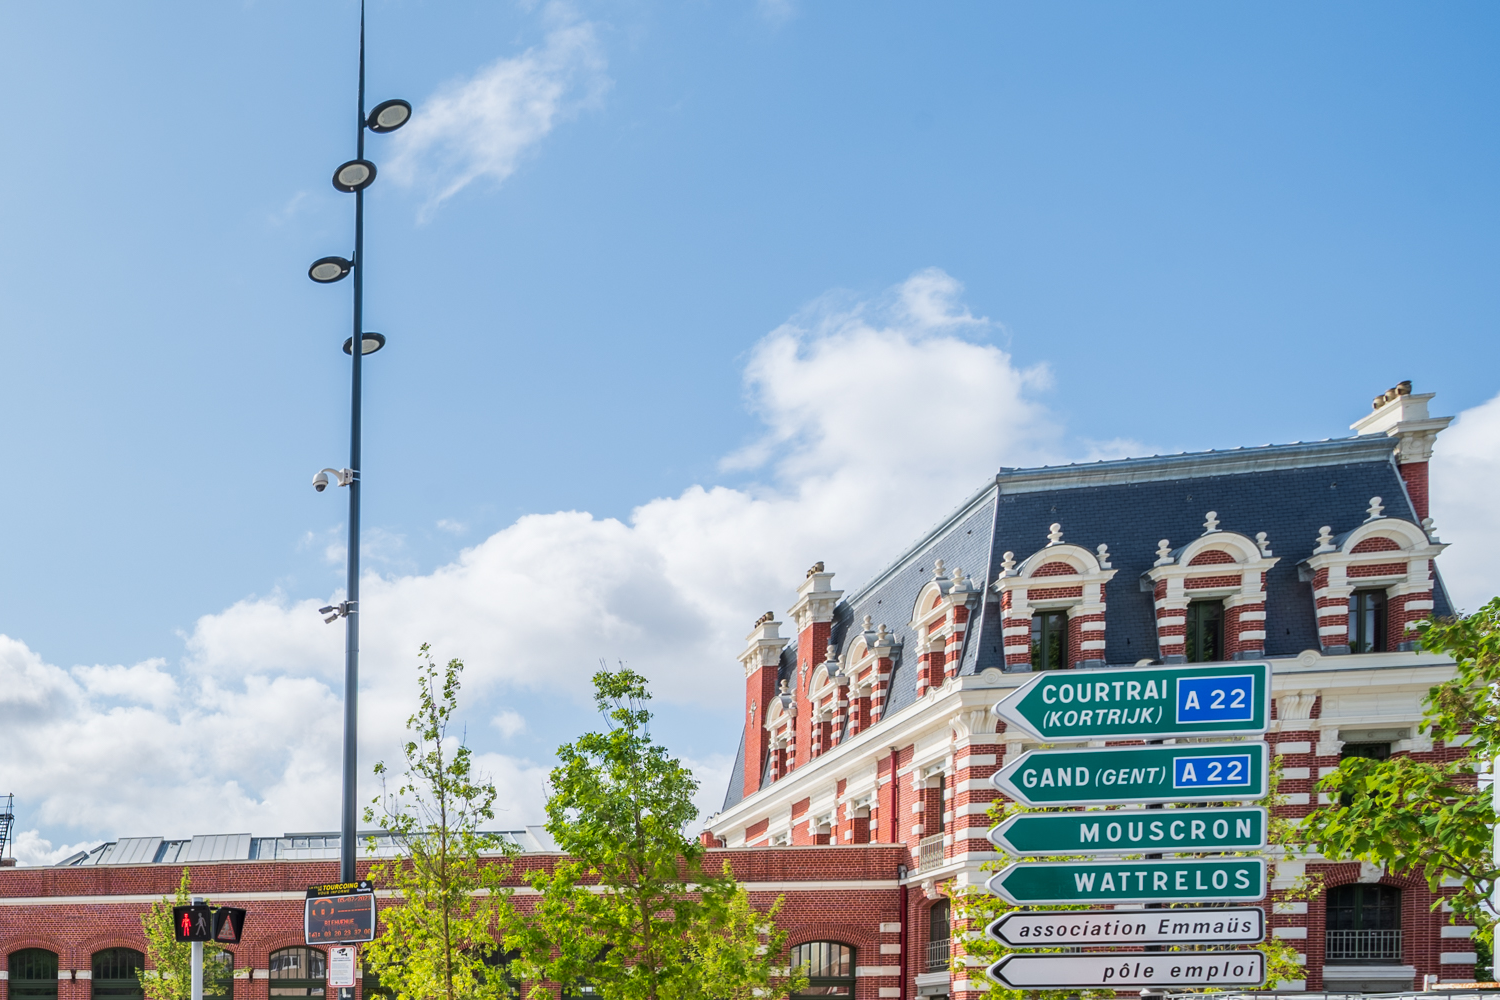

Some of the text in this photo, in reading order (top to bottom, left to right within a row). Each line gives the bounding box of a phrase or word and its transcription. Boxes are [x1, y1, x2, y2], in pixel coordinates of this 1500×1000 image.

[1042, 679, 1167, 704] COURTRAI
[1184, 688, 1246, 710] A 22
[1042, 706, 1163, 728] (KORTRIJK)
[1022, 765, 1167, 788] GAND (GENT)
[1182, 761, 1243, 782] A 22
[1079, 818, 1251, 843] MOUSCRON
[323, 882, 359, 891] TOURCOING
[1074, 869, 1250, 892] WATTRELOS
[1019, 917, 1252, 938] association Emmaüs
[1102, 961, 1254, 982] pôle emploi
